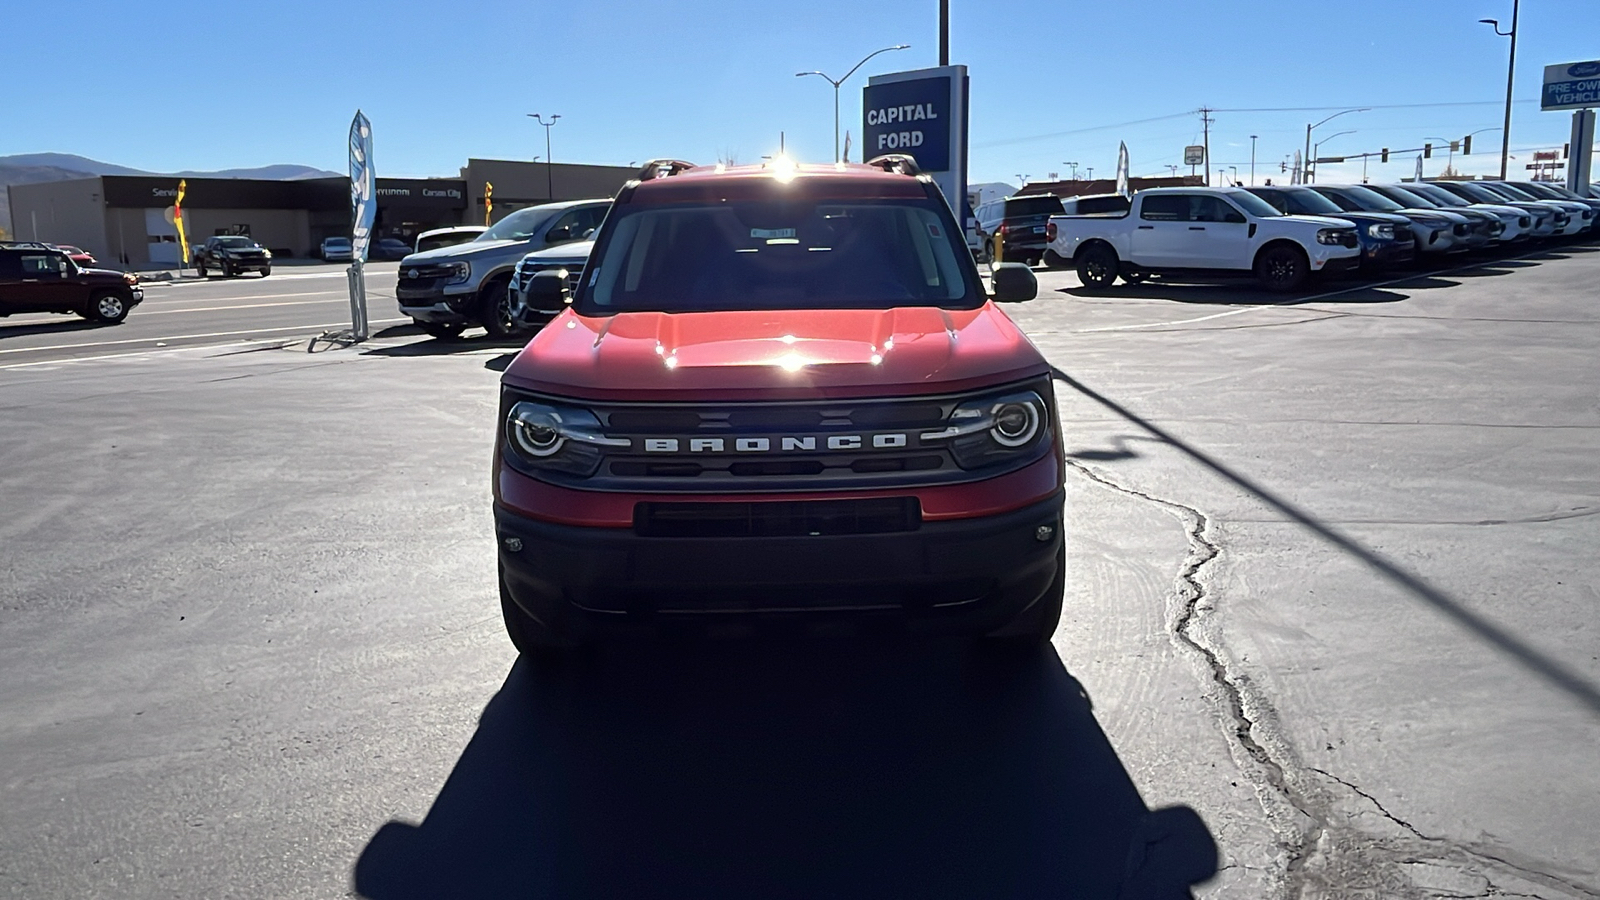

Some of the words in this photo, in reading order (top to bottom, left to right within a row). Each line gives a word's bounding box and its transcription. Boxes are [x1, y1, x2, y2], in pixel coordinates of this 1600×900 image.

[1555, 91, 1600, 104] VEHICL
[867, 103, 938, 126] CAPITAL
[878, 130, 924, 150] FORD
[422, 188, 447, 198] Carson
[447, 188, 461, 199] City
[644, 433, 907, 452] BRONCO
